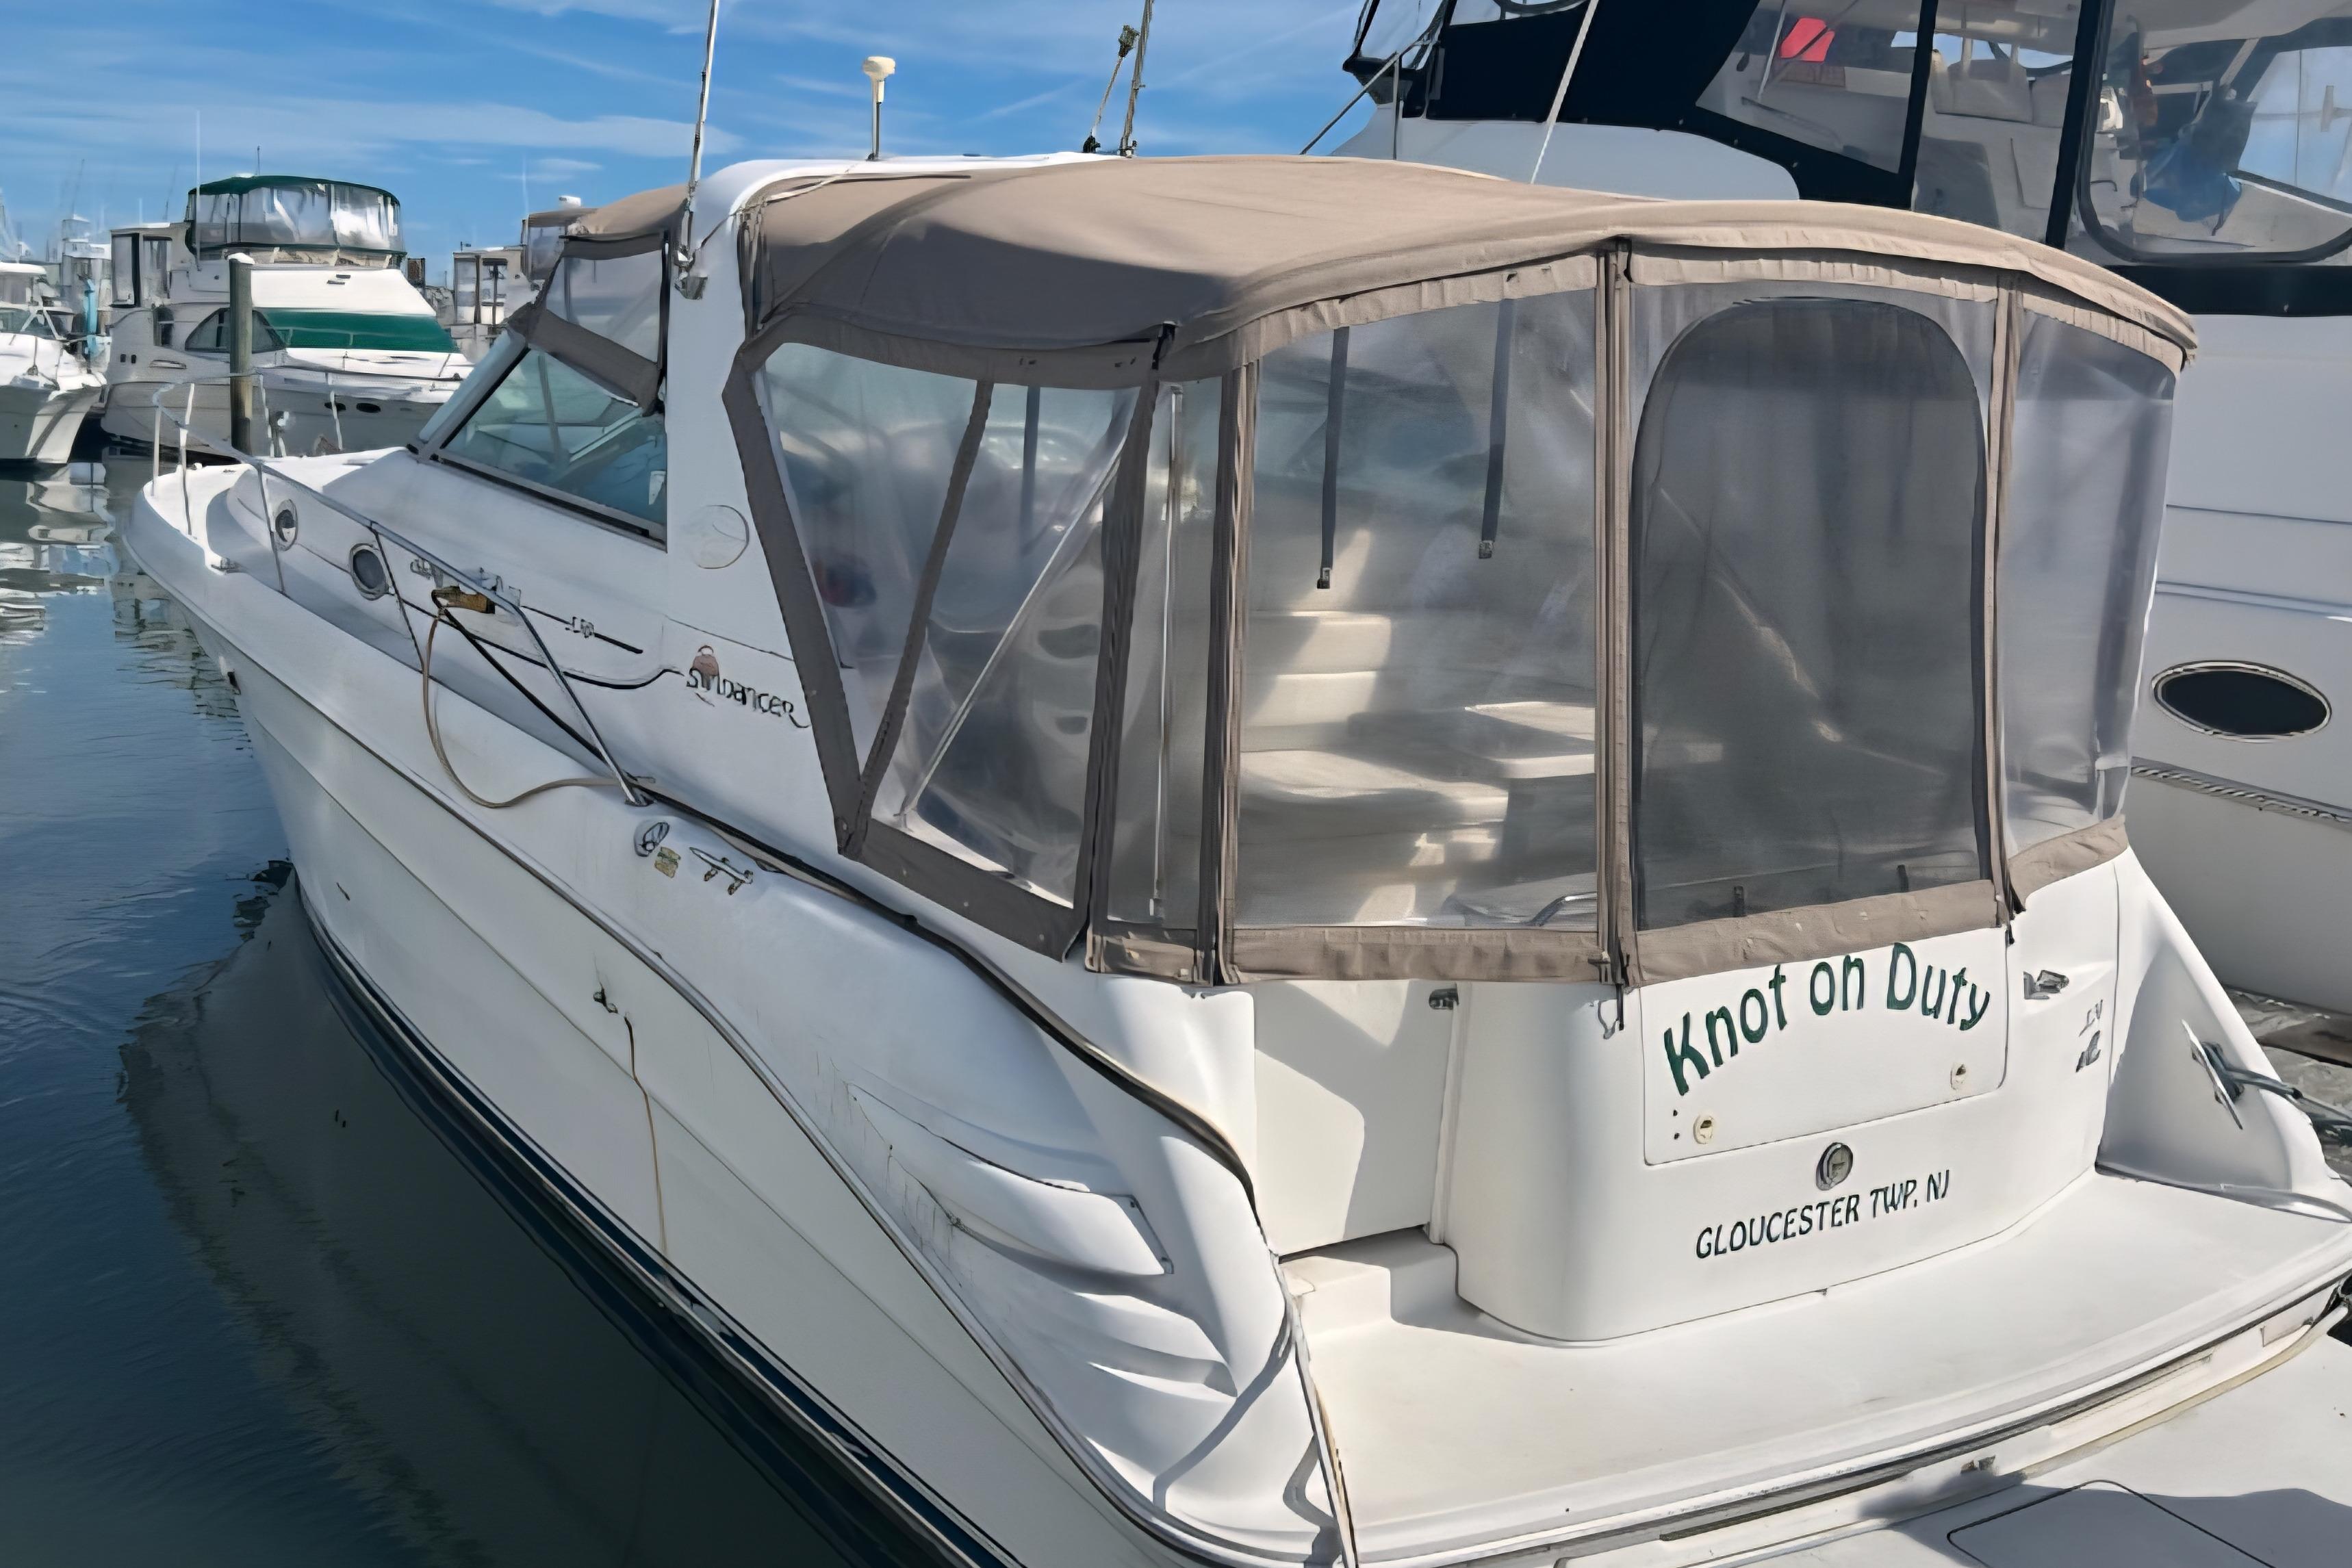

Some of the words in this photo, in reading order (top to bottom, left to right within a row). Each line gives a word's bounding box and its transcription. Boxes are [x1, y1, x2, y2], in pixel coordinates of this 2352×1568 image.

[1663, 962, 1789, 1096] Knot
[1810, 954, 1865, 1016] on
[1887, 942, 1991, 1032] Duty
[1696, 1193, 1861, 1260] GLOUCESTER
[1869, 1179, 1918, 1219] TWP.
[1926, 1169, 1950, 1203] NJ
